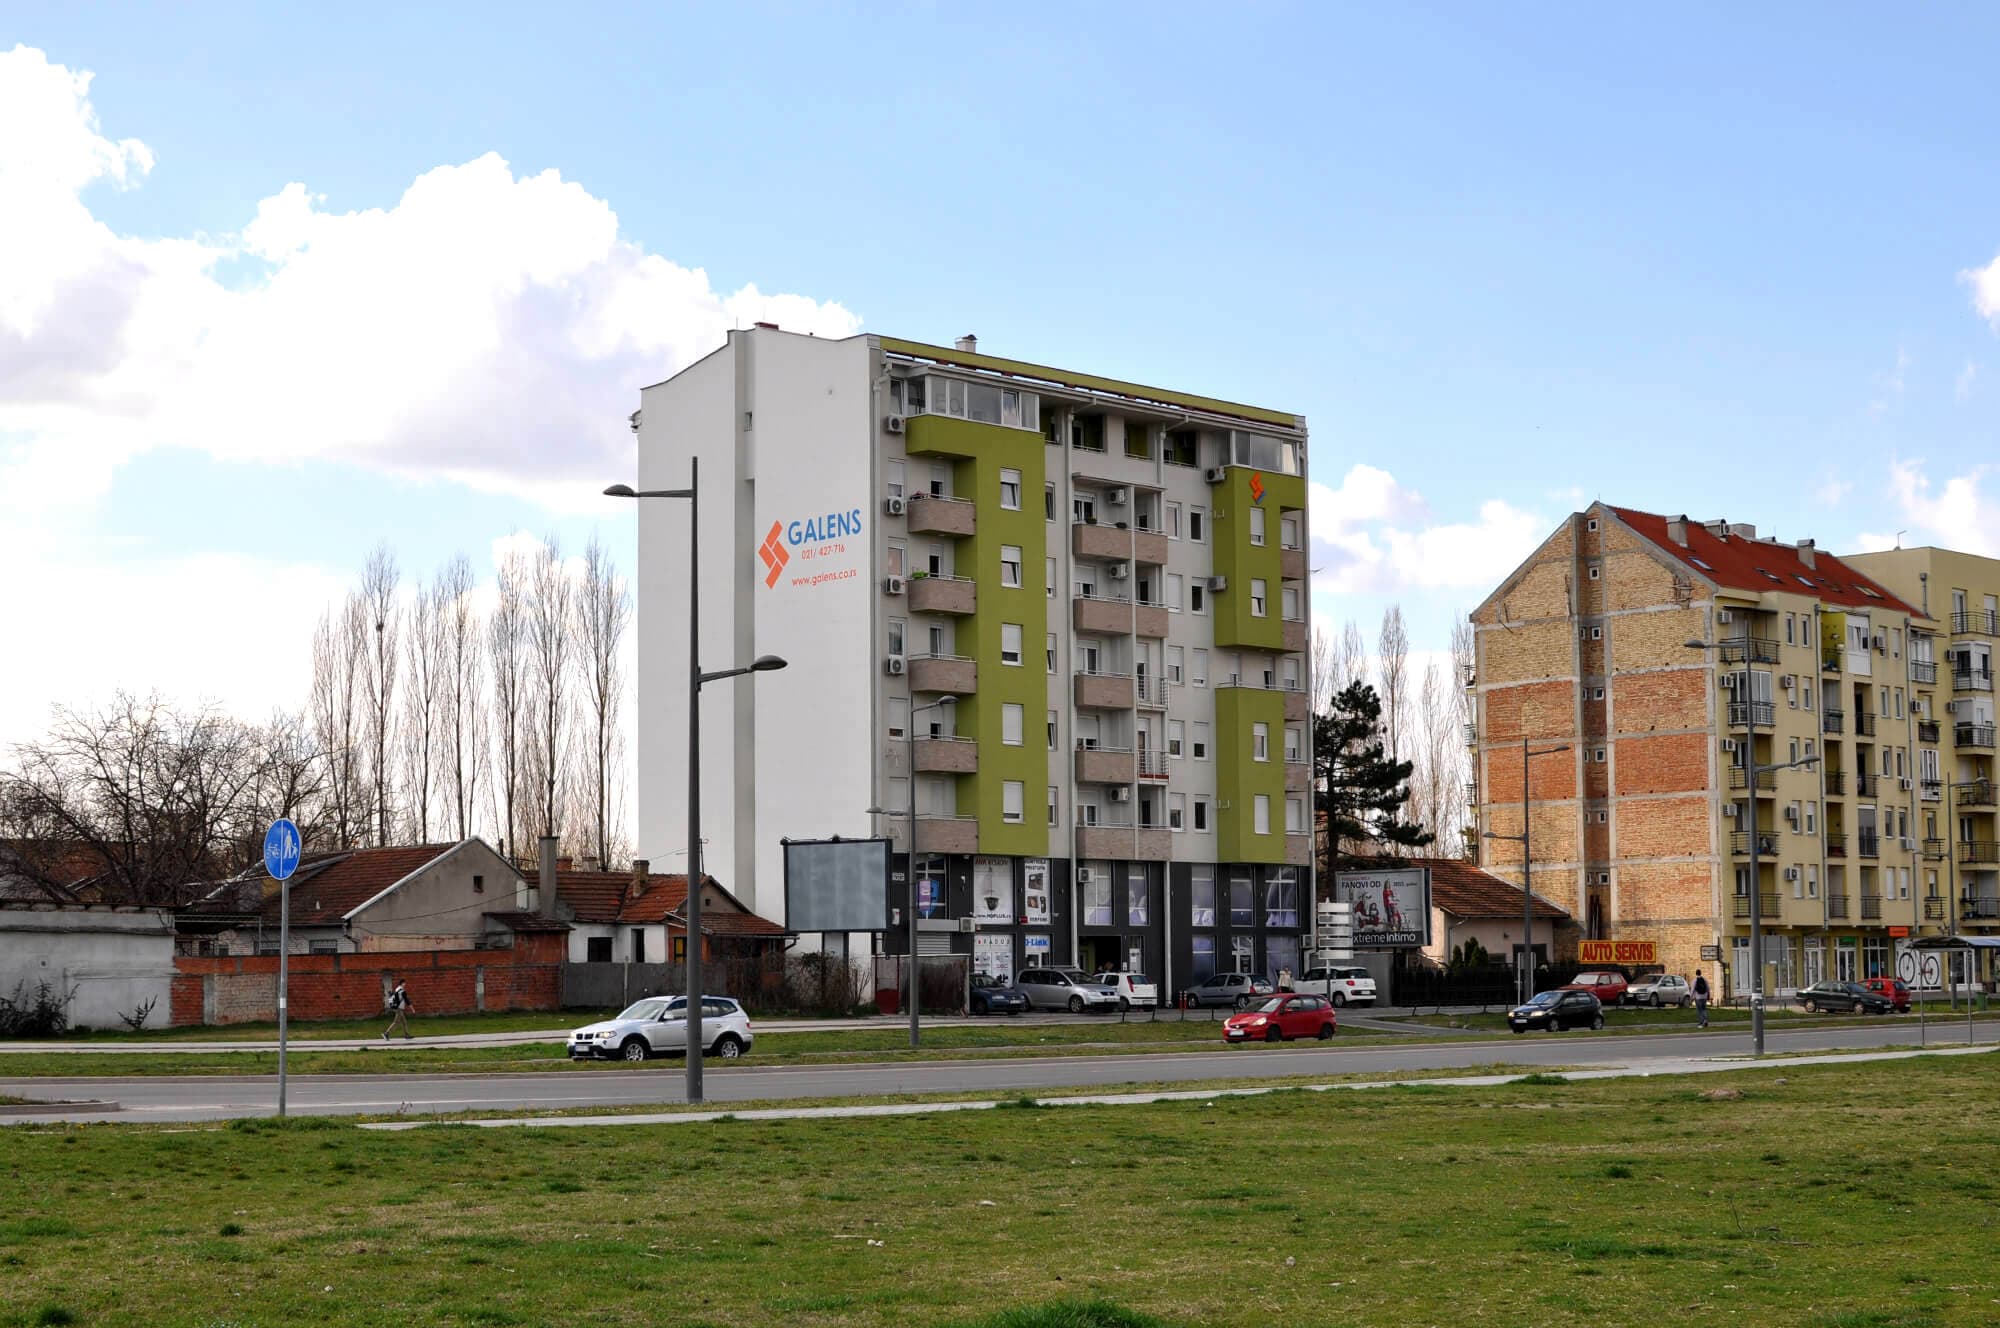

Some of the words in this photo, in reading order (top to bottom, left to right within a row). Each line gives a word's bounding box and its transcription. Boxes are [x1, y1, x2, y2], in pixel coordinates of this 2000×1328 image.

[788, 508, 862, 546] GALENS
[801, 548, 817, 560] 021/
[819, 543, 846, 556] 427-716
[791, 569, 857, 586] www.galens.co.rs
[1342, 881, 1368, 889] FANOVI
[1370, 880, 1381, 888] OD
[1353, 934, 1386, 943] xtreme
[1581, 943, 1613, 961] AUTO
[1615, 943, 1653, 961] SERVIS
